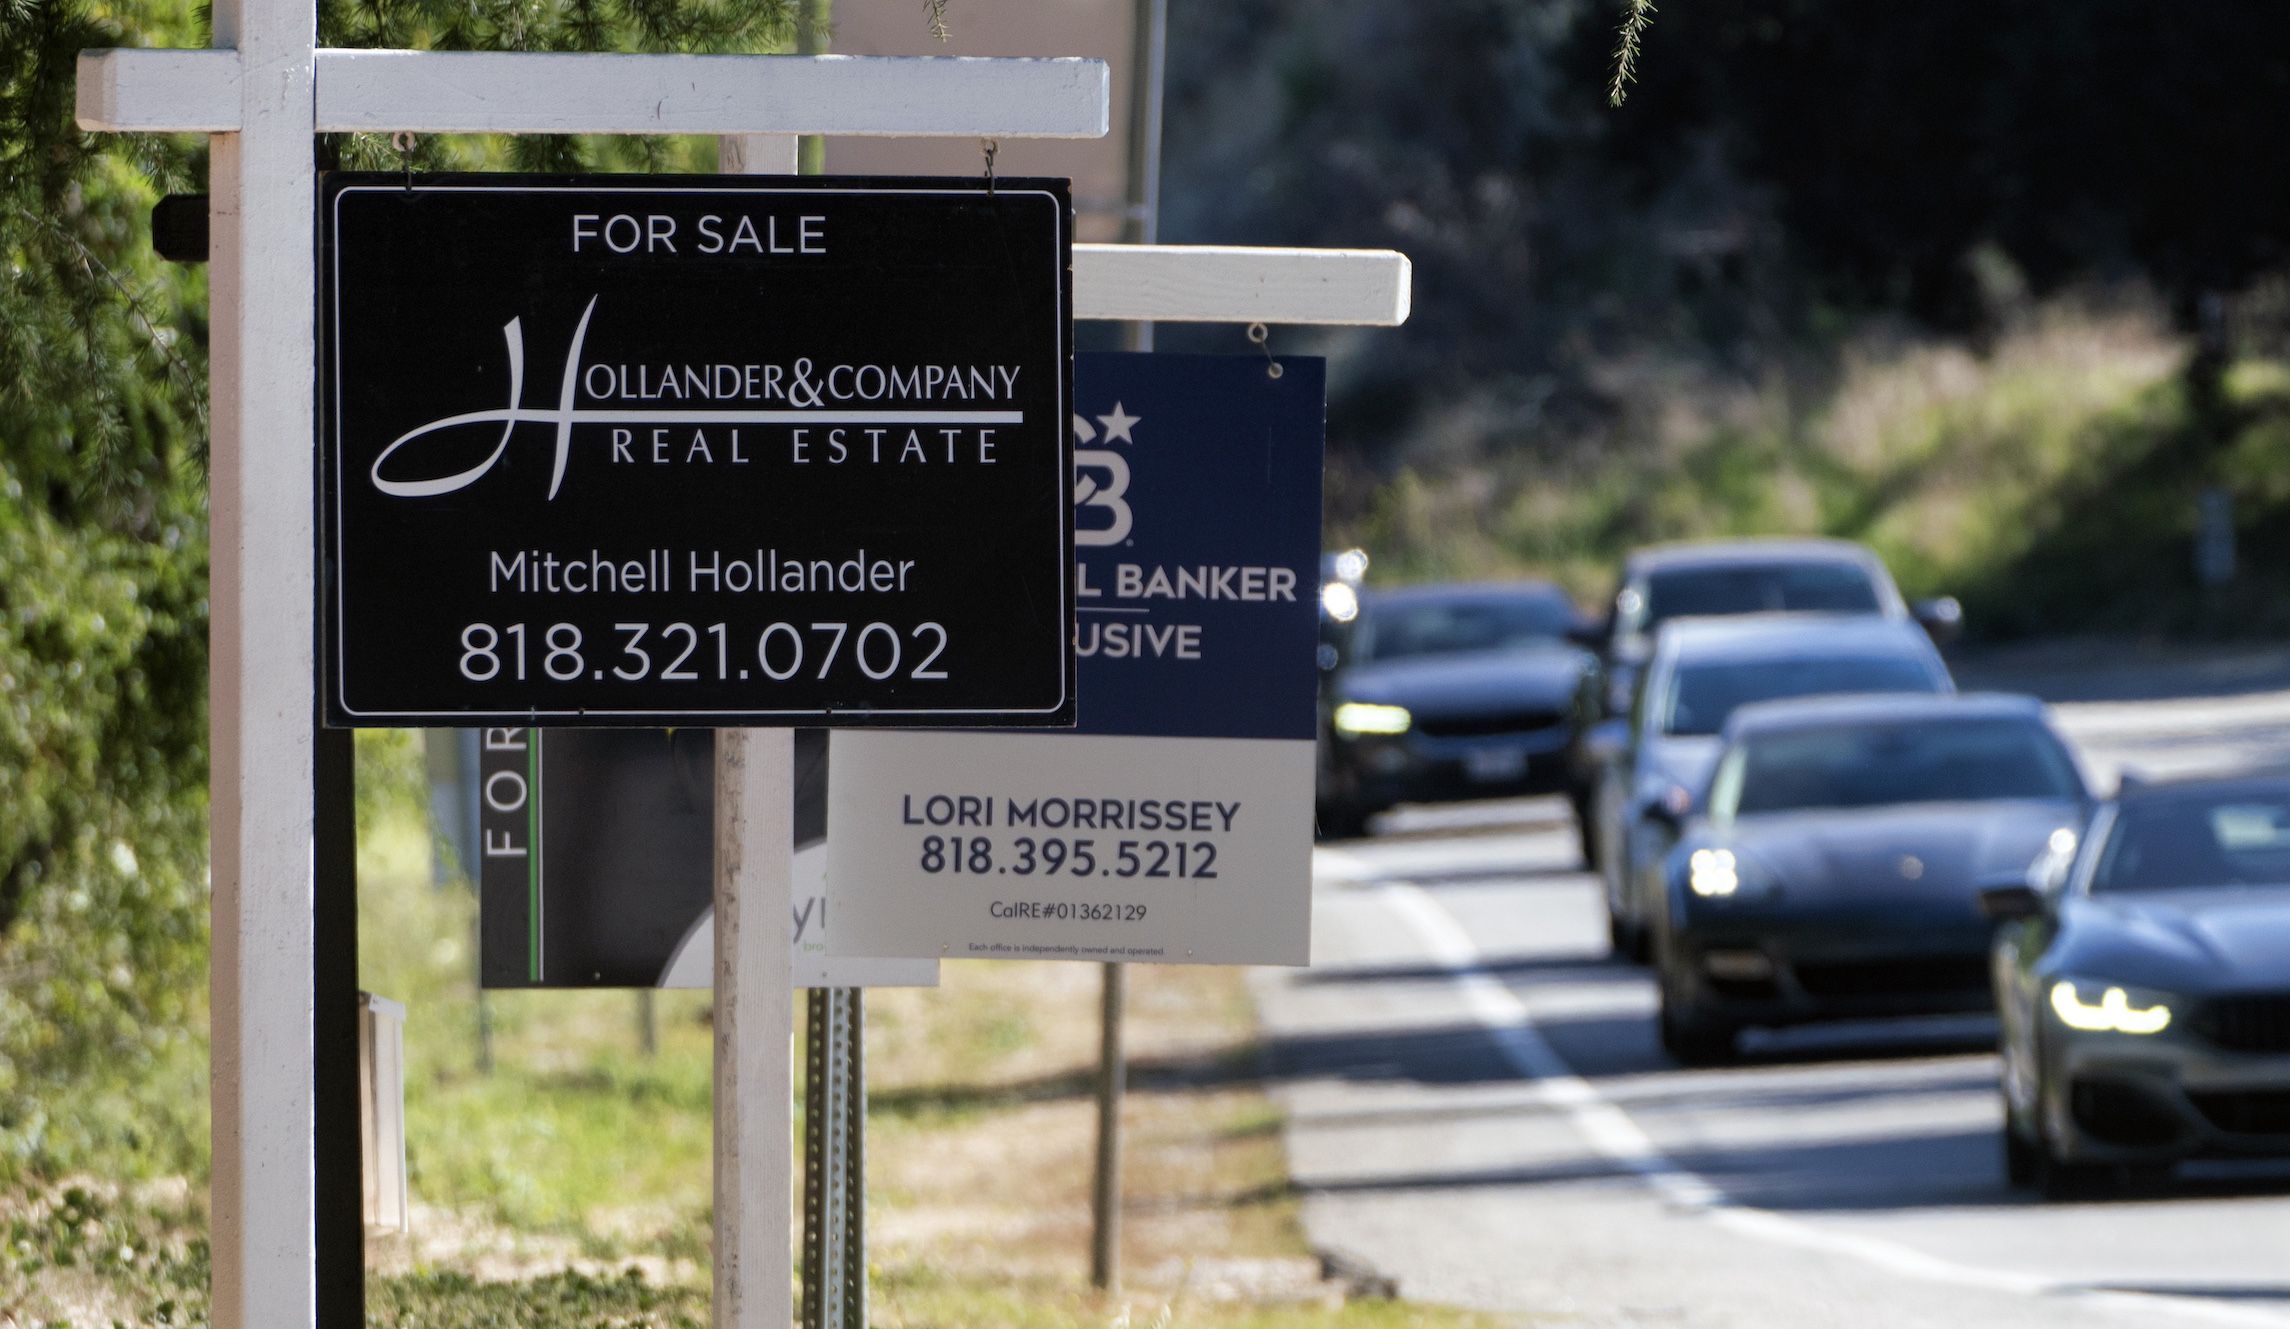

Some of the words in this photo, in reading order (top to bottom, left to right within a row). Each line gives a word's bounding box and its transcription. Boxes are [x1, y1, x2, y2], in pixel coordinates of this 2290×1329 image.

[573, 214, 677, 253] FOR
[697, 214, 827, 254] SALE
[612, 429, 749, 463] REAL
[793, 429, 997, 464] ESTATE
[491, 549, 670, 593] Mitchell
[690, 549, 915, 593] Hollander
[1117, 563, 1297, 602] BANKER
[459, 622, 949, 682] 818.321.0702
[1075, 622, 1202, 659] USIVE
[485, 728, 528, 856] FOR
[903, 794, 993, 827] LORI
[1007, 797, 1241, 832] MORRISSEY
[920, 835, 1218, 879] 818.395.5212
[990, 901, 1147, 921] CalRE#01362129
[968, 942, 988, 951] Each
[989, 943, 1012, 952] office
[1013, 944, 1021, 952] is
[1022, 944, 1079, 955] independently
[1081, 946, 1109, 954] owned
[1109, 946, 1126, 954] and
